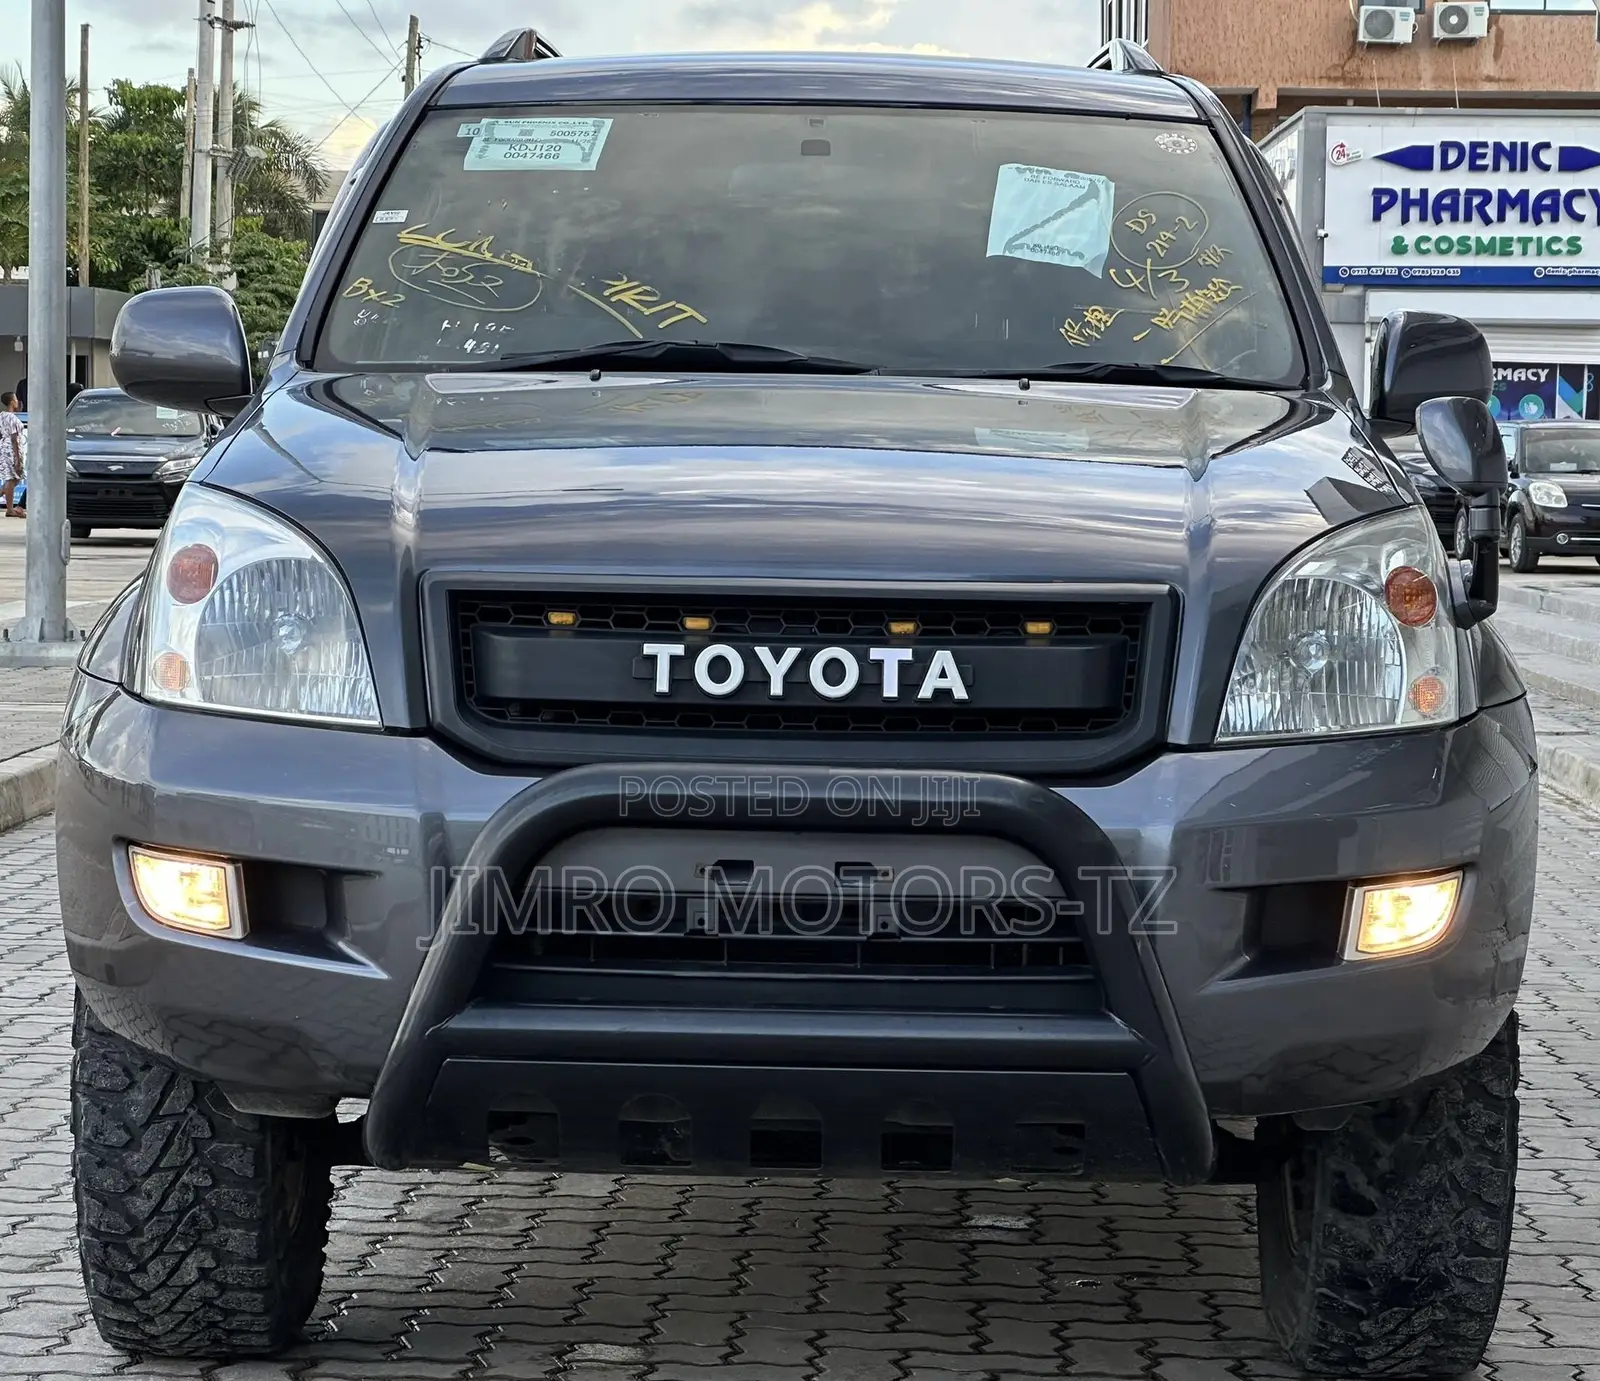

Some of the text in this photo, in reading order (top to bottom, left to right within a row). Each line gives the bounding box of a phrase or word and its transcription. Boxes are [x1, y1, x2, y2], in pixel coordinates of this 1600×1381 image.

[465, 127, 480, 136] 10
[508, 144, 562, 152] KDJ120
[1439, 140, 1553, 172] DENIC
[1390, 235, 1584, 256] & COSMETICS
[642, 642, 971, 701] TOYOTA
